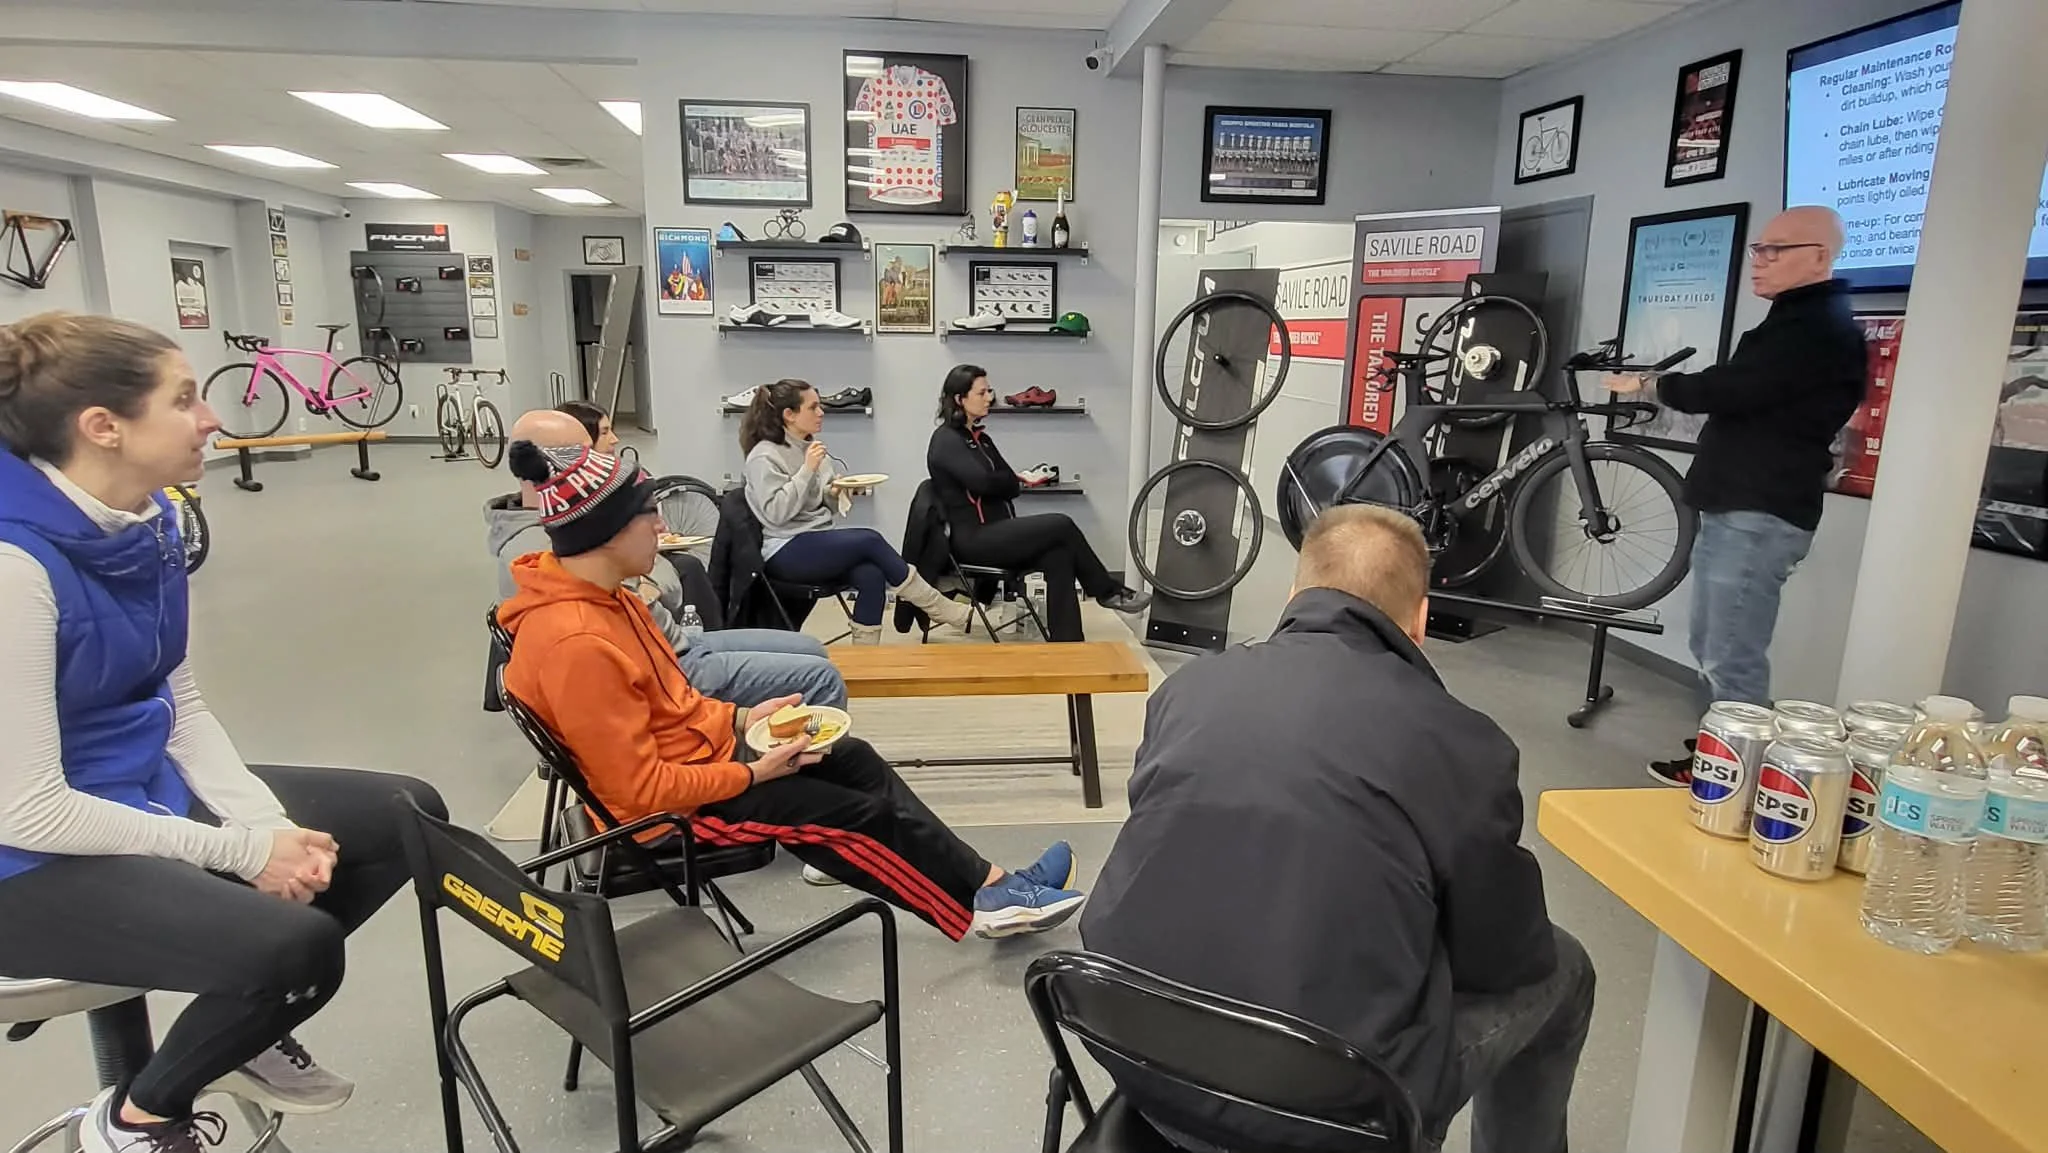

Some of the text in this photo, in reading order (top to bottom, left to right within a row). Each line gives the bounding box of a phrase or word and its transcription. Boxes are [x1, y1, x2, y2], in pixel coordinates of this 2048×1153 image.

[1819, 69, 1858, 87] Regular
[1861, 48, 1932, 76] Maintenance
[1841, 75, 1892, 96] Cleaning:
[1895, 66, 1925, 82] Wash
[1841, 99, 1856, 112] dirt
[1858, 91, 1897, 108] buildup,
[1901, 81, 1932, 98] which
[891, 123, 917, 135] UAE
[1840, 122, 1870, 137] Chain
[1872, 116, 1904, 131] Lube:
[1906, 108, 1935, 123] Wipe
[1839, 137, 1866, 151] chain
[1867, 134, 1891, 148] lube,
[1895, 129, 1918, 142] then
[1838, 141, 1934, 167] miles or after riding
[1838, 169, 1930, 191] Lubricate Moving
[1837, 184, 1927, 207] points lightly oiled.
[1884, 214, 1902, 226] For
[369, 234, 446, 242] FULCRUM
[659, 234, 708, 242] RICHMOND
[1369, 234, 1477, 257] SAVILE ROAD
[1868, 231, 1886, 241] and
[1849, 248, 1873, 258] once
[1875, 247, 1886, 256] or
[1889, 244, 1915, 255] twice
[1312, 275, 1348, 309] ROAD
[1684, 293, 1716, 303] FIELDS
[1370, 312, 1388, 343] THE
